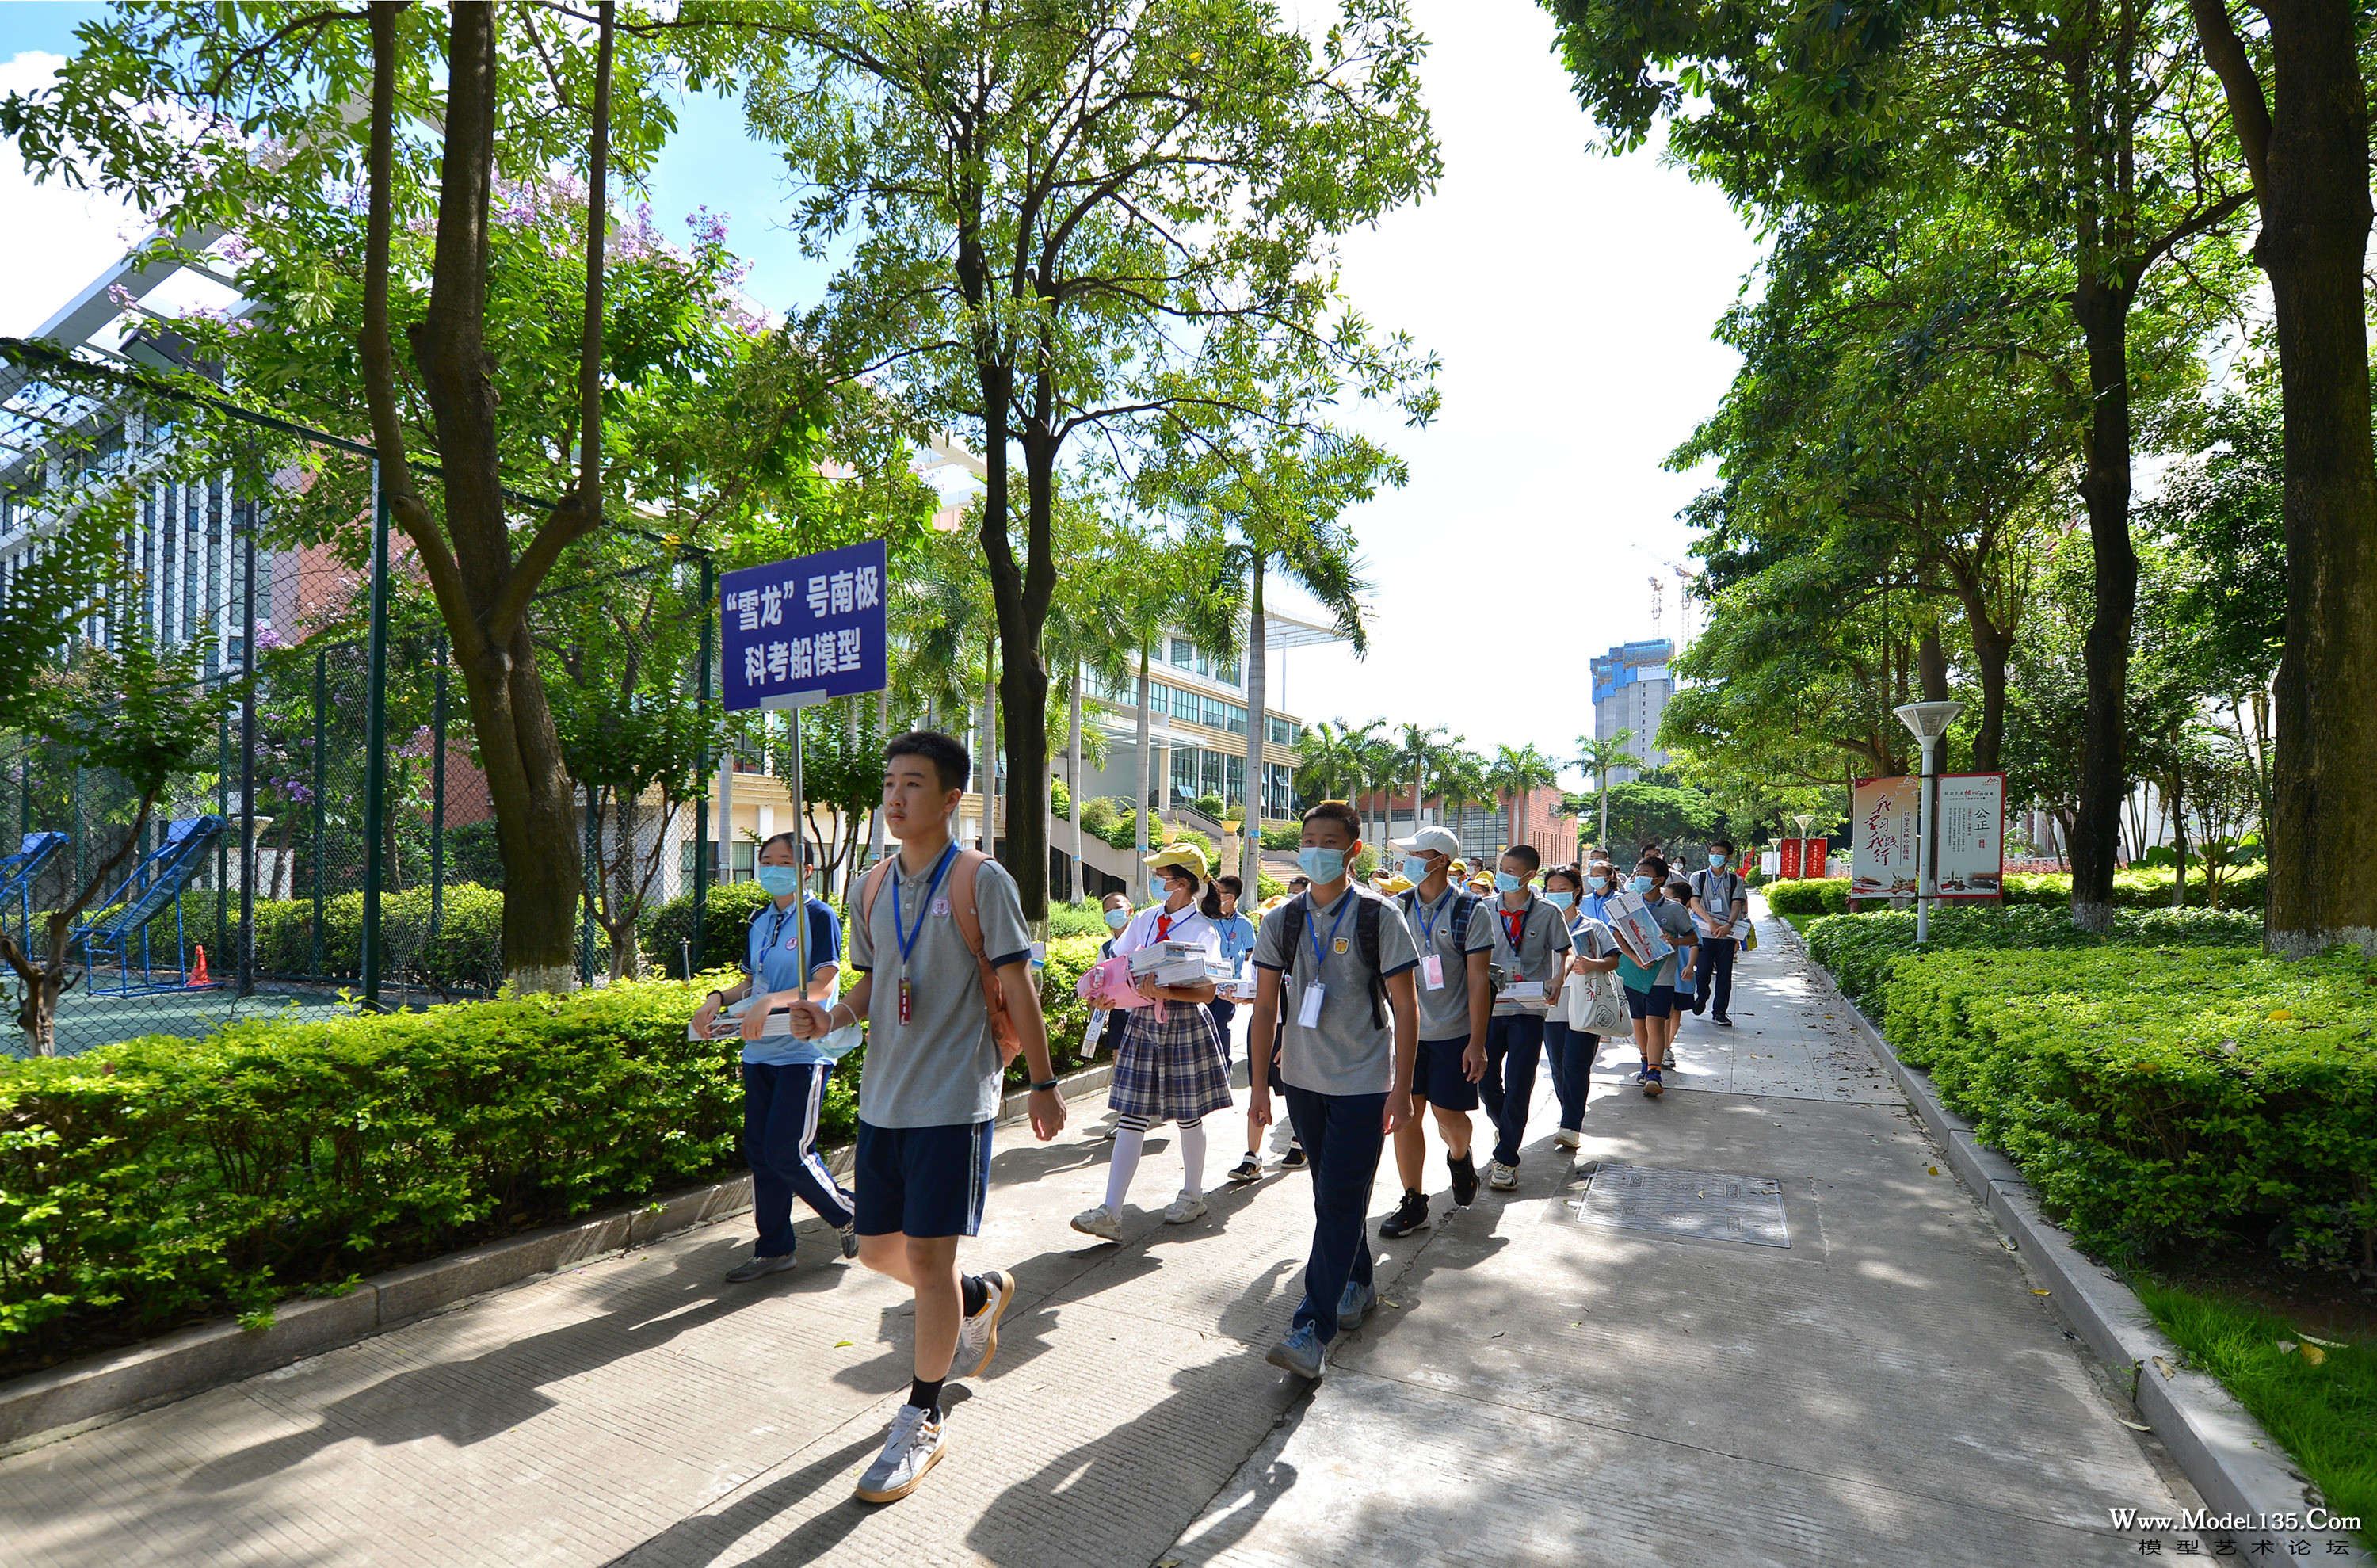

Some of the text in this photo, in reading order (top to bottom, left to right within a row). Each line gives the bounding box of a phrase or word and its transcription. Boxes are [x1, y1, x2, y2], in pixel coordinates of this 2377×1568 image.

[745, 627, 861, 687] 科考船模型
[1974, 807, 1990, 830] 公正
